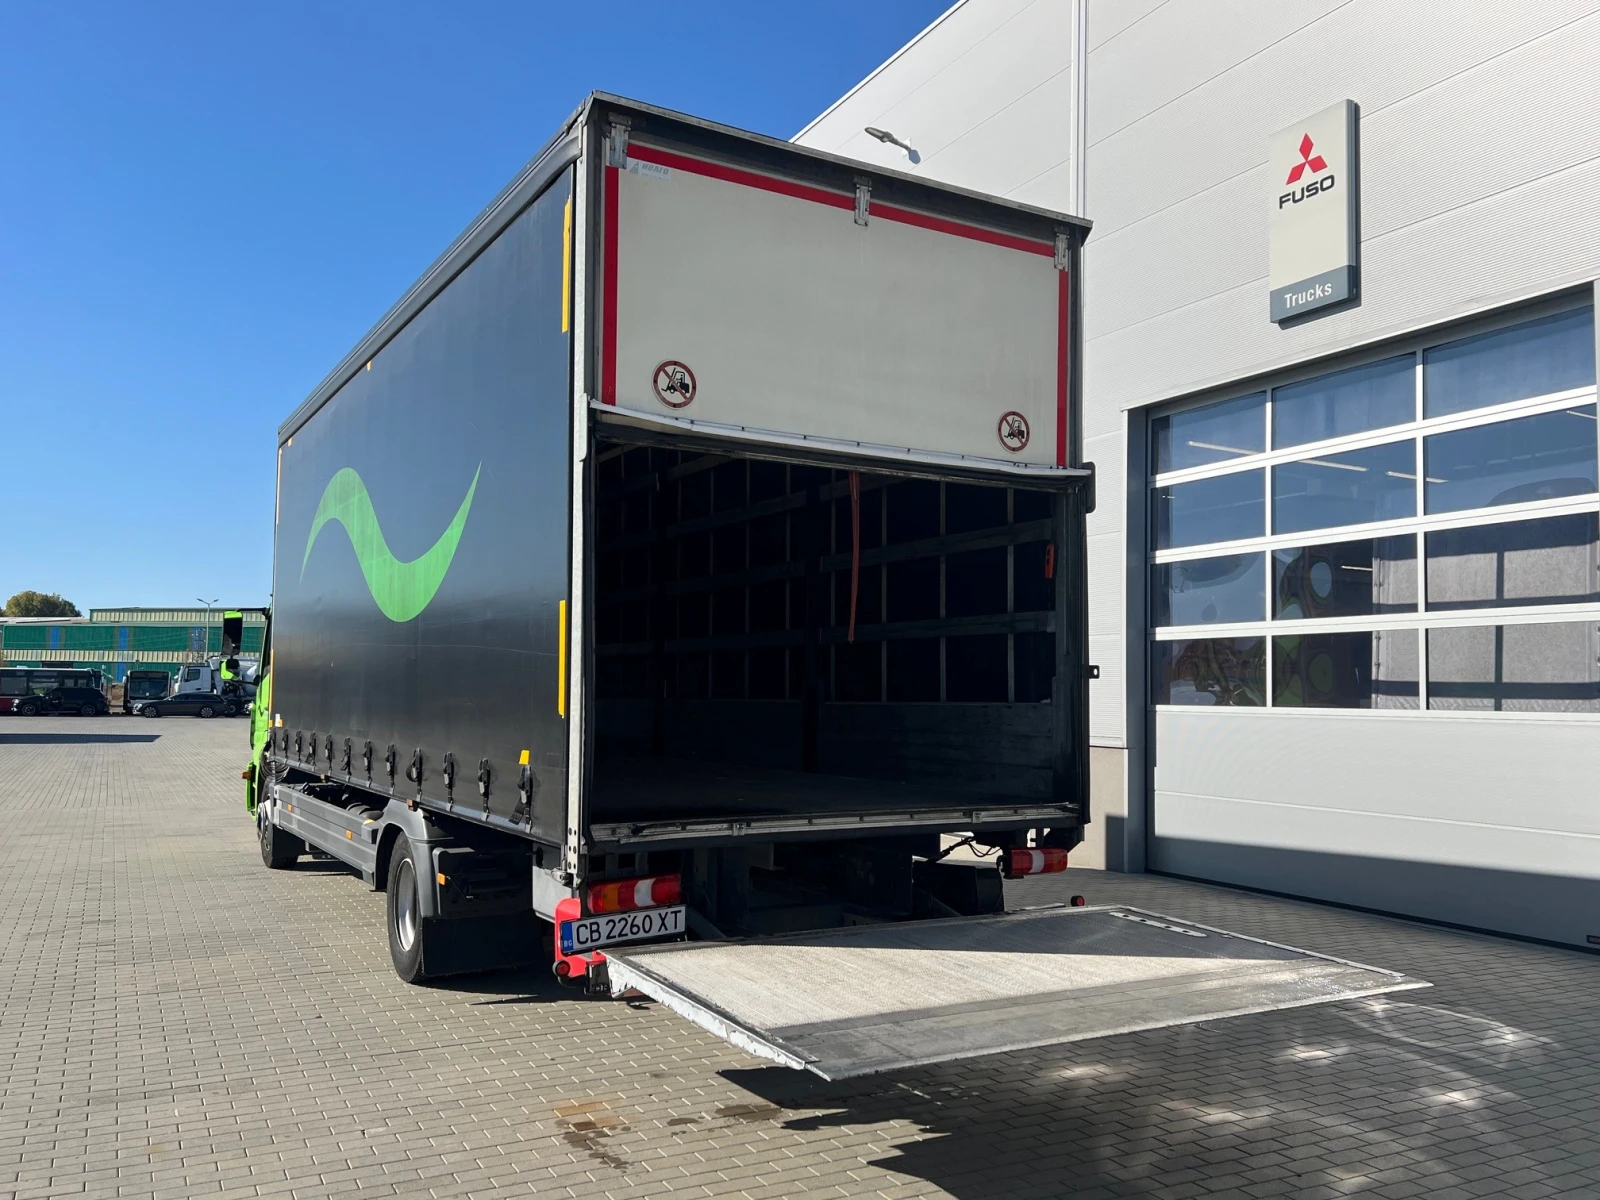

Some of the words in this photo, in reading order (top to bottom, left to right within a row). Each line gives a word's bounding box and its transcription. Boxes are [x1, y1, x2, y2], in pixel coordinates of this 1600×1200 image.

[1279, 174, 1335, 209] FUSO
[1284, 283, 1332, 308] Trucks
[576, 921, 602, 945] CB
[605, 914, 653, 940] 2260
[657, 910, 682, 933] XT
[563, 940, 573, 948] BG
